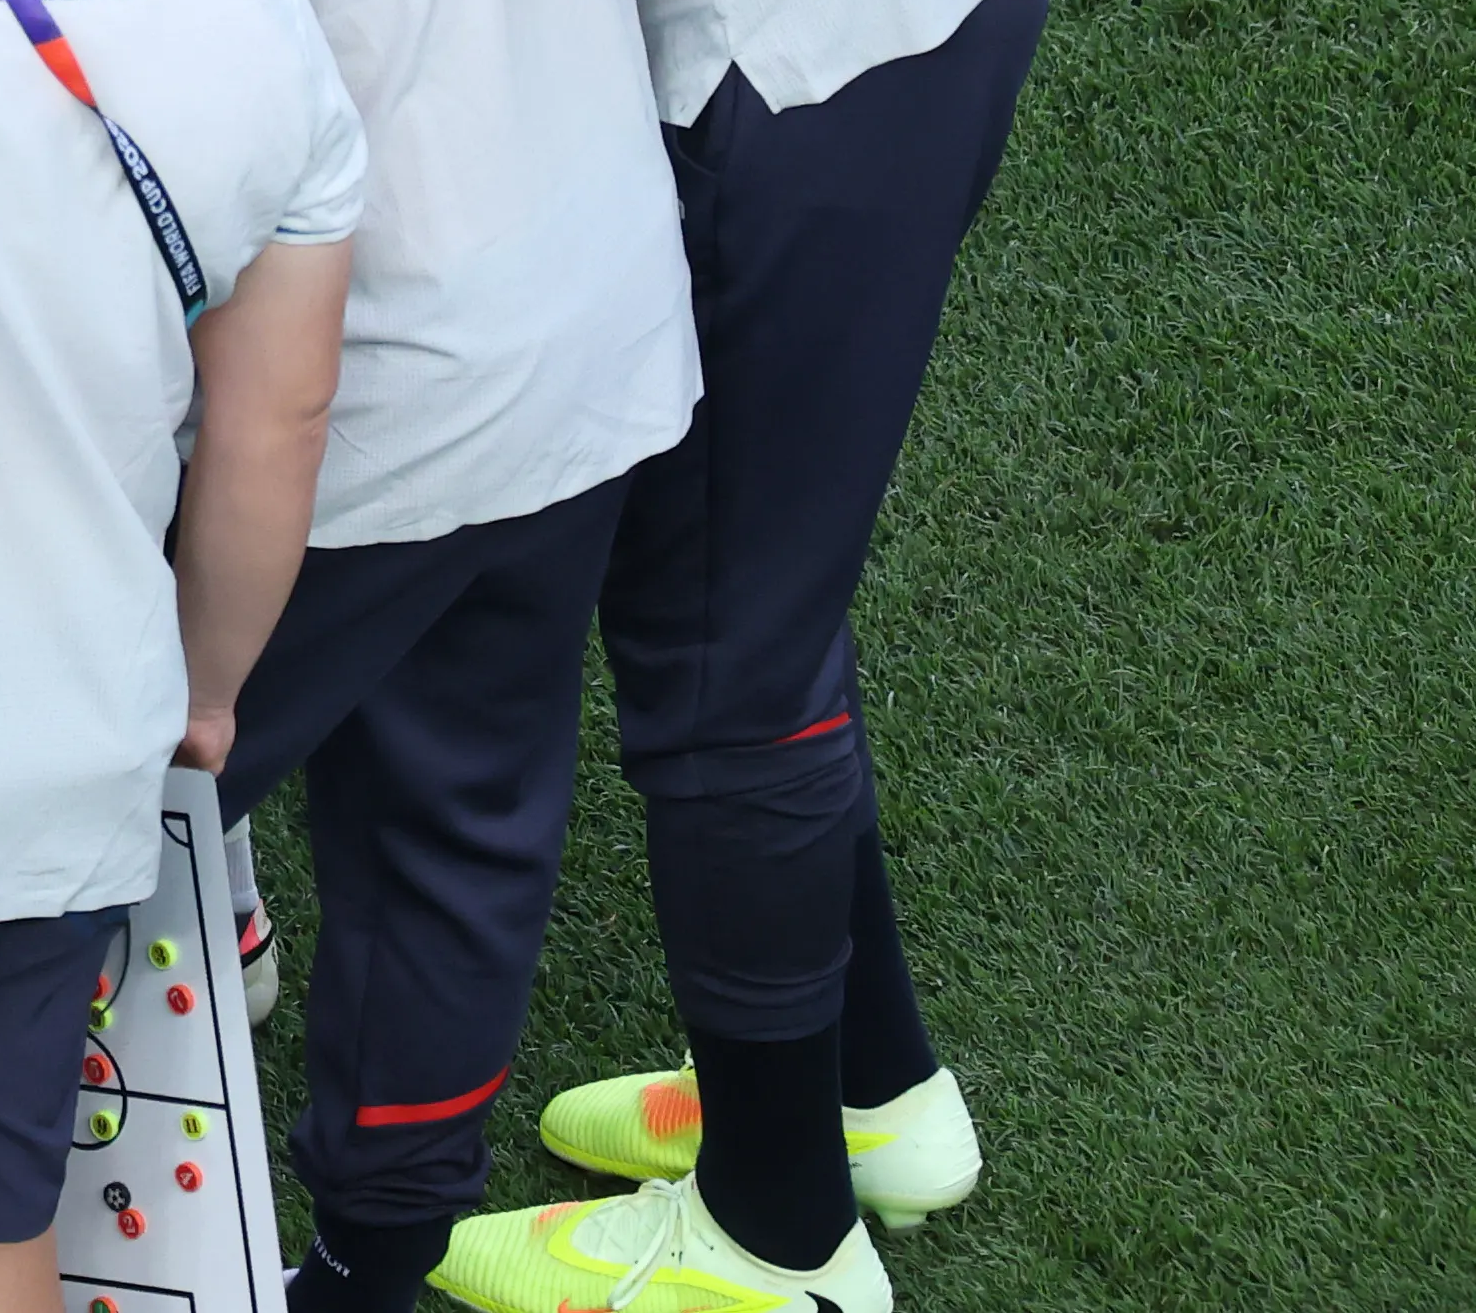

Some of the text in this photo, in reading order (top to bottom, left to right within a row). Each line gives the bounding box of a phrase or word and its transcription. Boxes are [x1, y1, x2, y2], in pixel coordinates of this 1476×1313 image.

[140, 179, 168, 215] CUP
[157, 211, 192, 269] WORLD
[180, 264, 201, 297] FIFA
